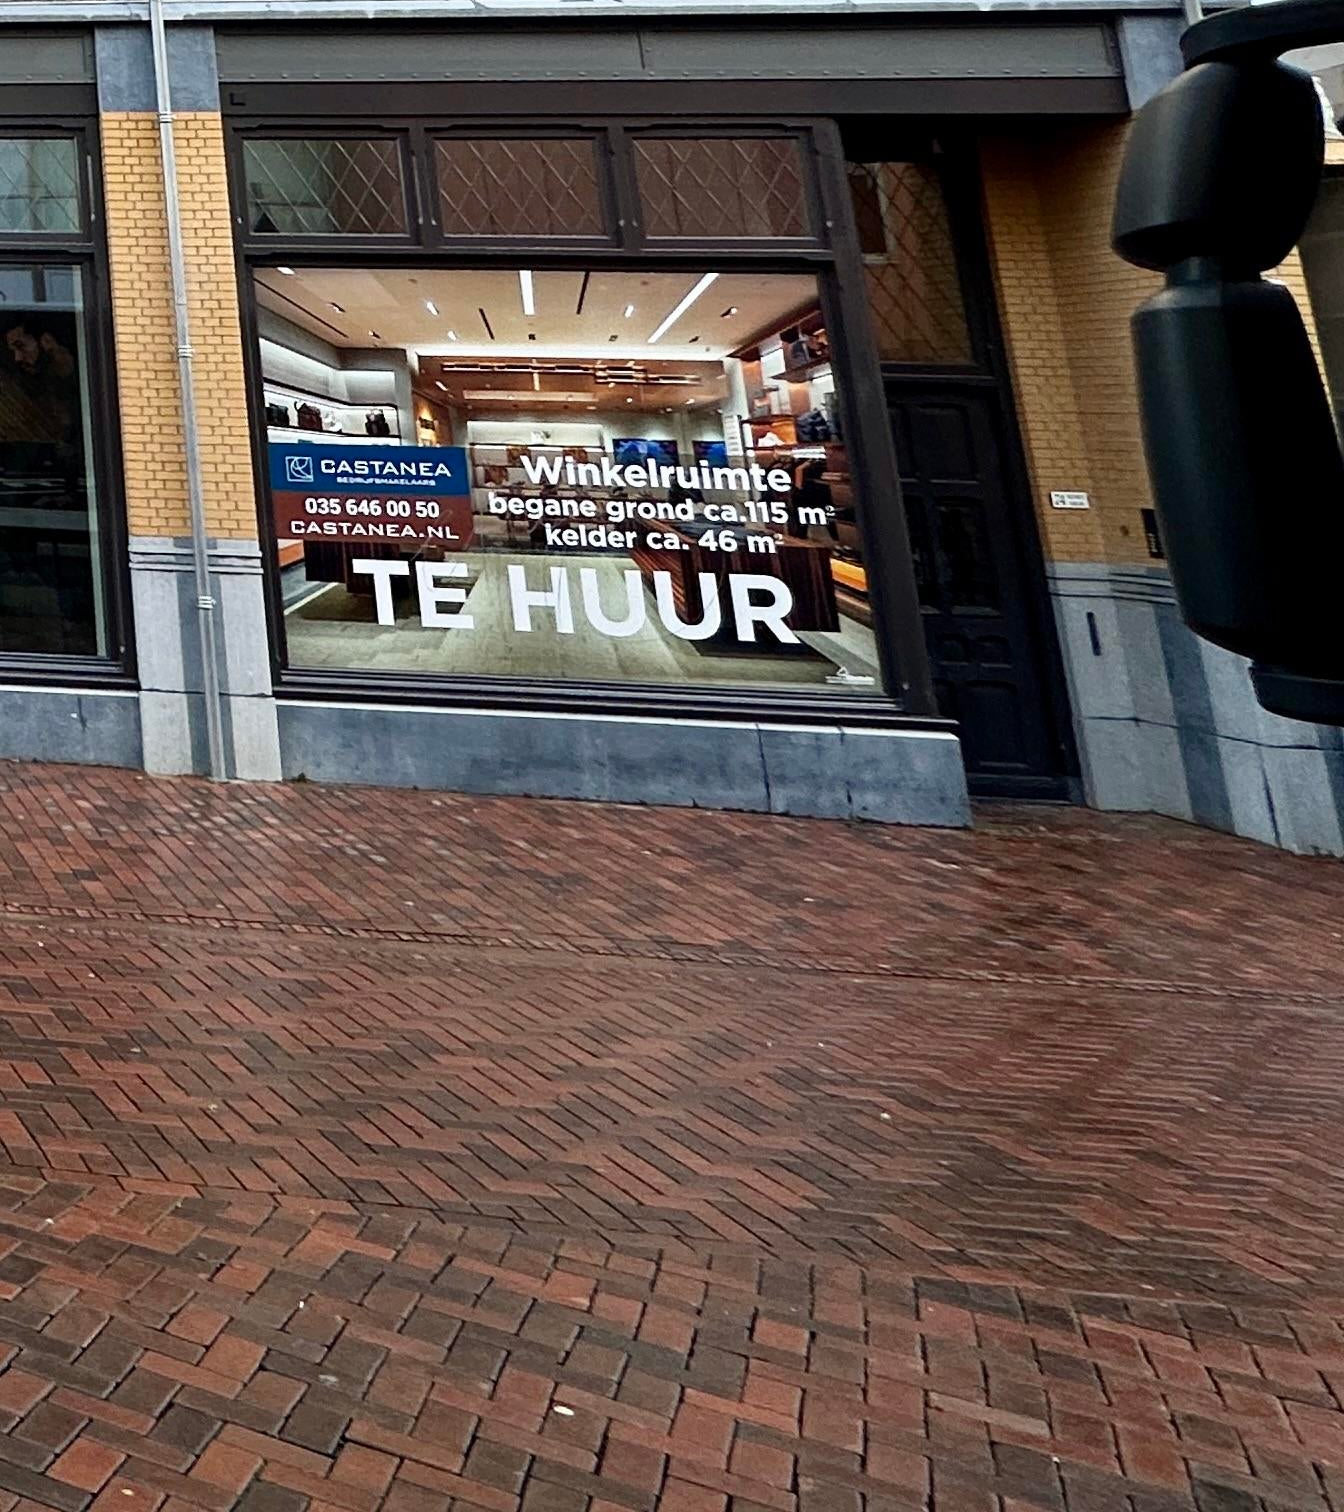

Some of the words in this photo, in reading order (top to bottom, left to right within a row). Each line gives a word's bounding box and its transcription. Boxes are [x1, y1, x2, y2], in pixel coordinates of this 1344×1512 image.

[320, 459, 452, 477] CASTANEA
[520, 455, 792, 492] Winkelruimte
[304, 497, 342, 515] 035
[345, 498, 382, 516] 646
[386, 500, 411, 517] 00
[415, 501, 439, 518] 50
[488, 491, 597, 520] begane
[606, 498, 695, 523] grond
[703, 501, 789, 524] ca.115
[290, 520, 459, 539] CASTANEA.NL
[545, 523, 638, 548] kelder
[646, 531, 689, 550] ca.
[698, 529, 738, 552] 46
[352, 559, 474, 630] TE
[507, 564, 801, 644] HUUR
